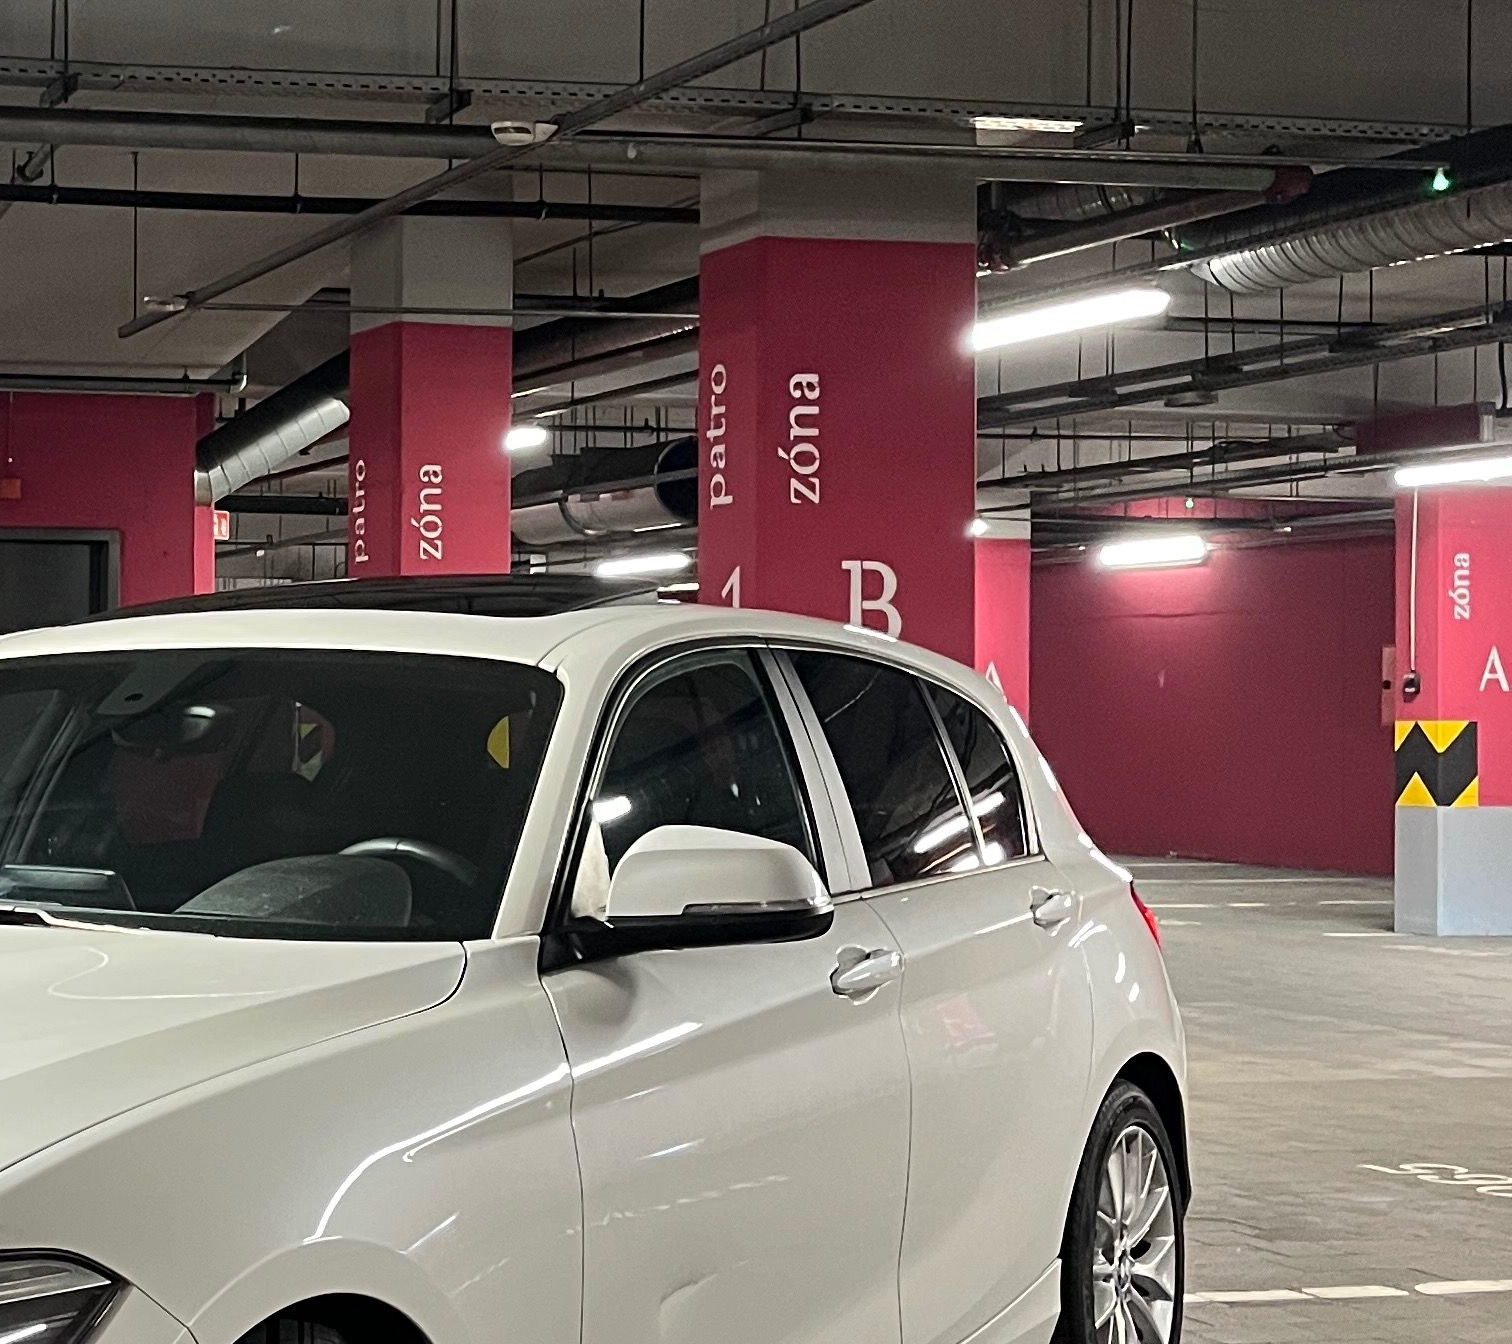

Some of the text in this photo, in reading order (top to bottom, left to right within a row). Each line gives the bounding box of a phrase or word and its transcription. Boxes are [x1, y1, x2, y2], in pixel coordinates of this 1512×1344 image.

[707, 363, 733, 510] patro
[778, 373, 820, 504] zóna
[352, 460, 368, 563] patro
[410, 464, 442, 560] zóna
[841, 560, 902, 642] B
[1448, 553, 1470, 619] zóna
[1479, 645, 1510, 692] A
